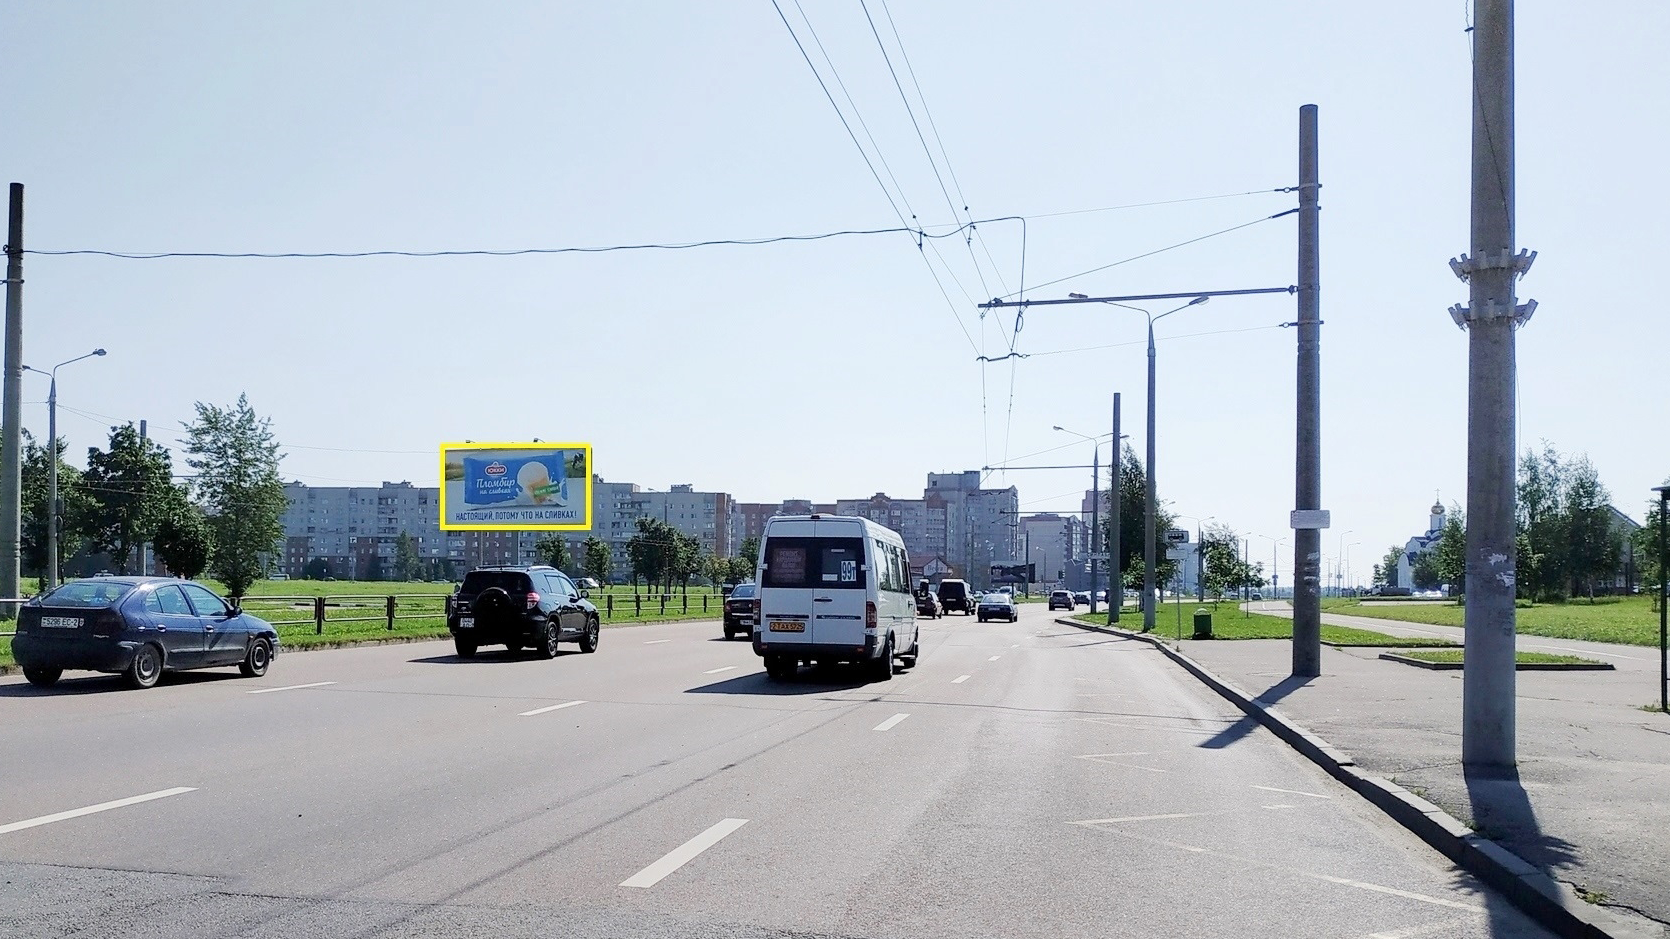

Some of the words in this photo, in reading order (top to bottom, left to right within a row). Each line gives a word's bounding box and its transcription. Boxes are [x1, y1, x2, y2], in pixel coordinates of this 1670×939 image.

[476, 476, 516, 489] Пломбир
[455, 511, 494, 521] НАСТОЯЩИЙ,
[495, 511, 519, 520] ПОТОМУ
[521, 510, 533, 520] ЧТО
[535, 510, 543, 519] НА
[545, 510, 577, 519] СЛИВКАХ!
